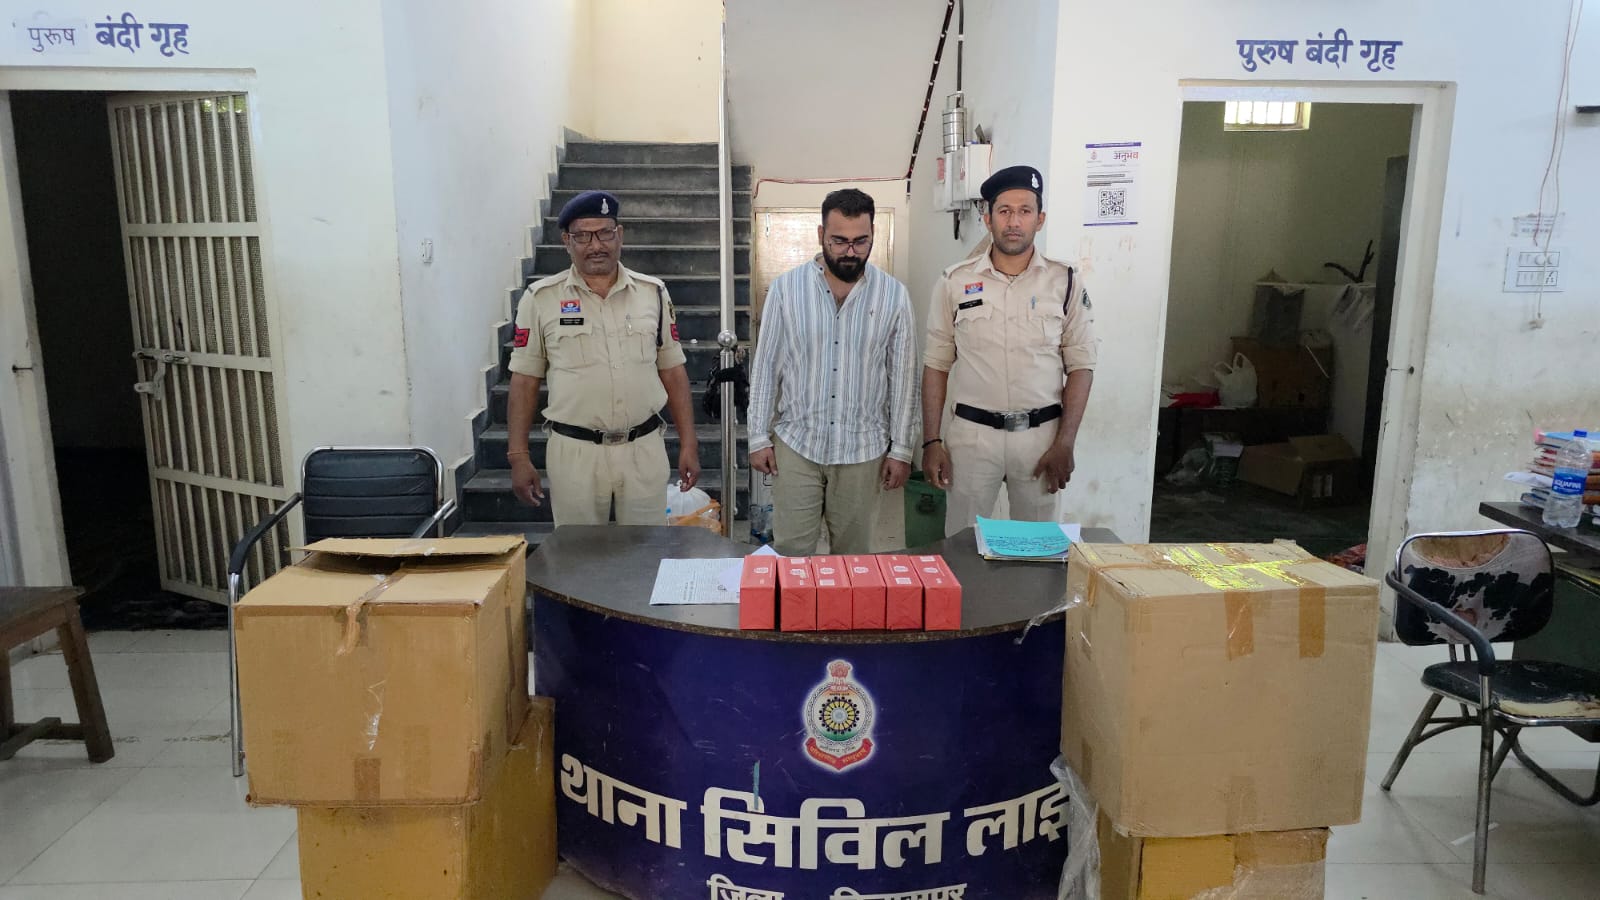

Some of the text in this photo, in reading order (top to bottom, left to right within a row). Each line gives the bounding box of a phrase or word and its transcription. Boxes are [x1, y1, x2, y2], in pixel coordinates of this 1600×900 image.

[95, 12, 144, 53] बंदी
[149, 23, 190, 57] गृह
[1236, 28, 1403, 72] पुरुष बंदी गृह
[560, 753, 1069, 870] थाना सिविल लाइ
